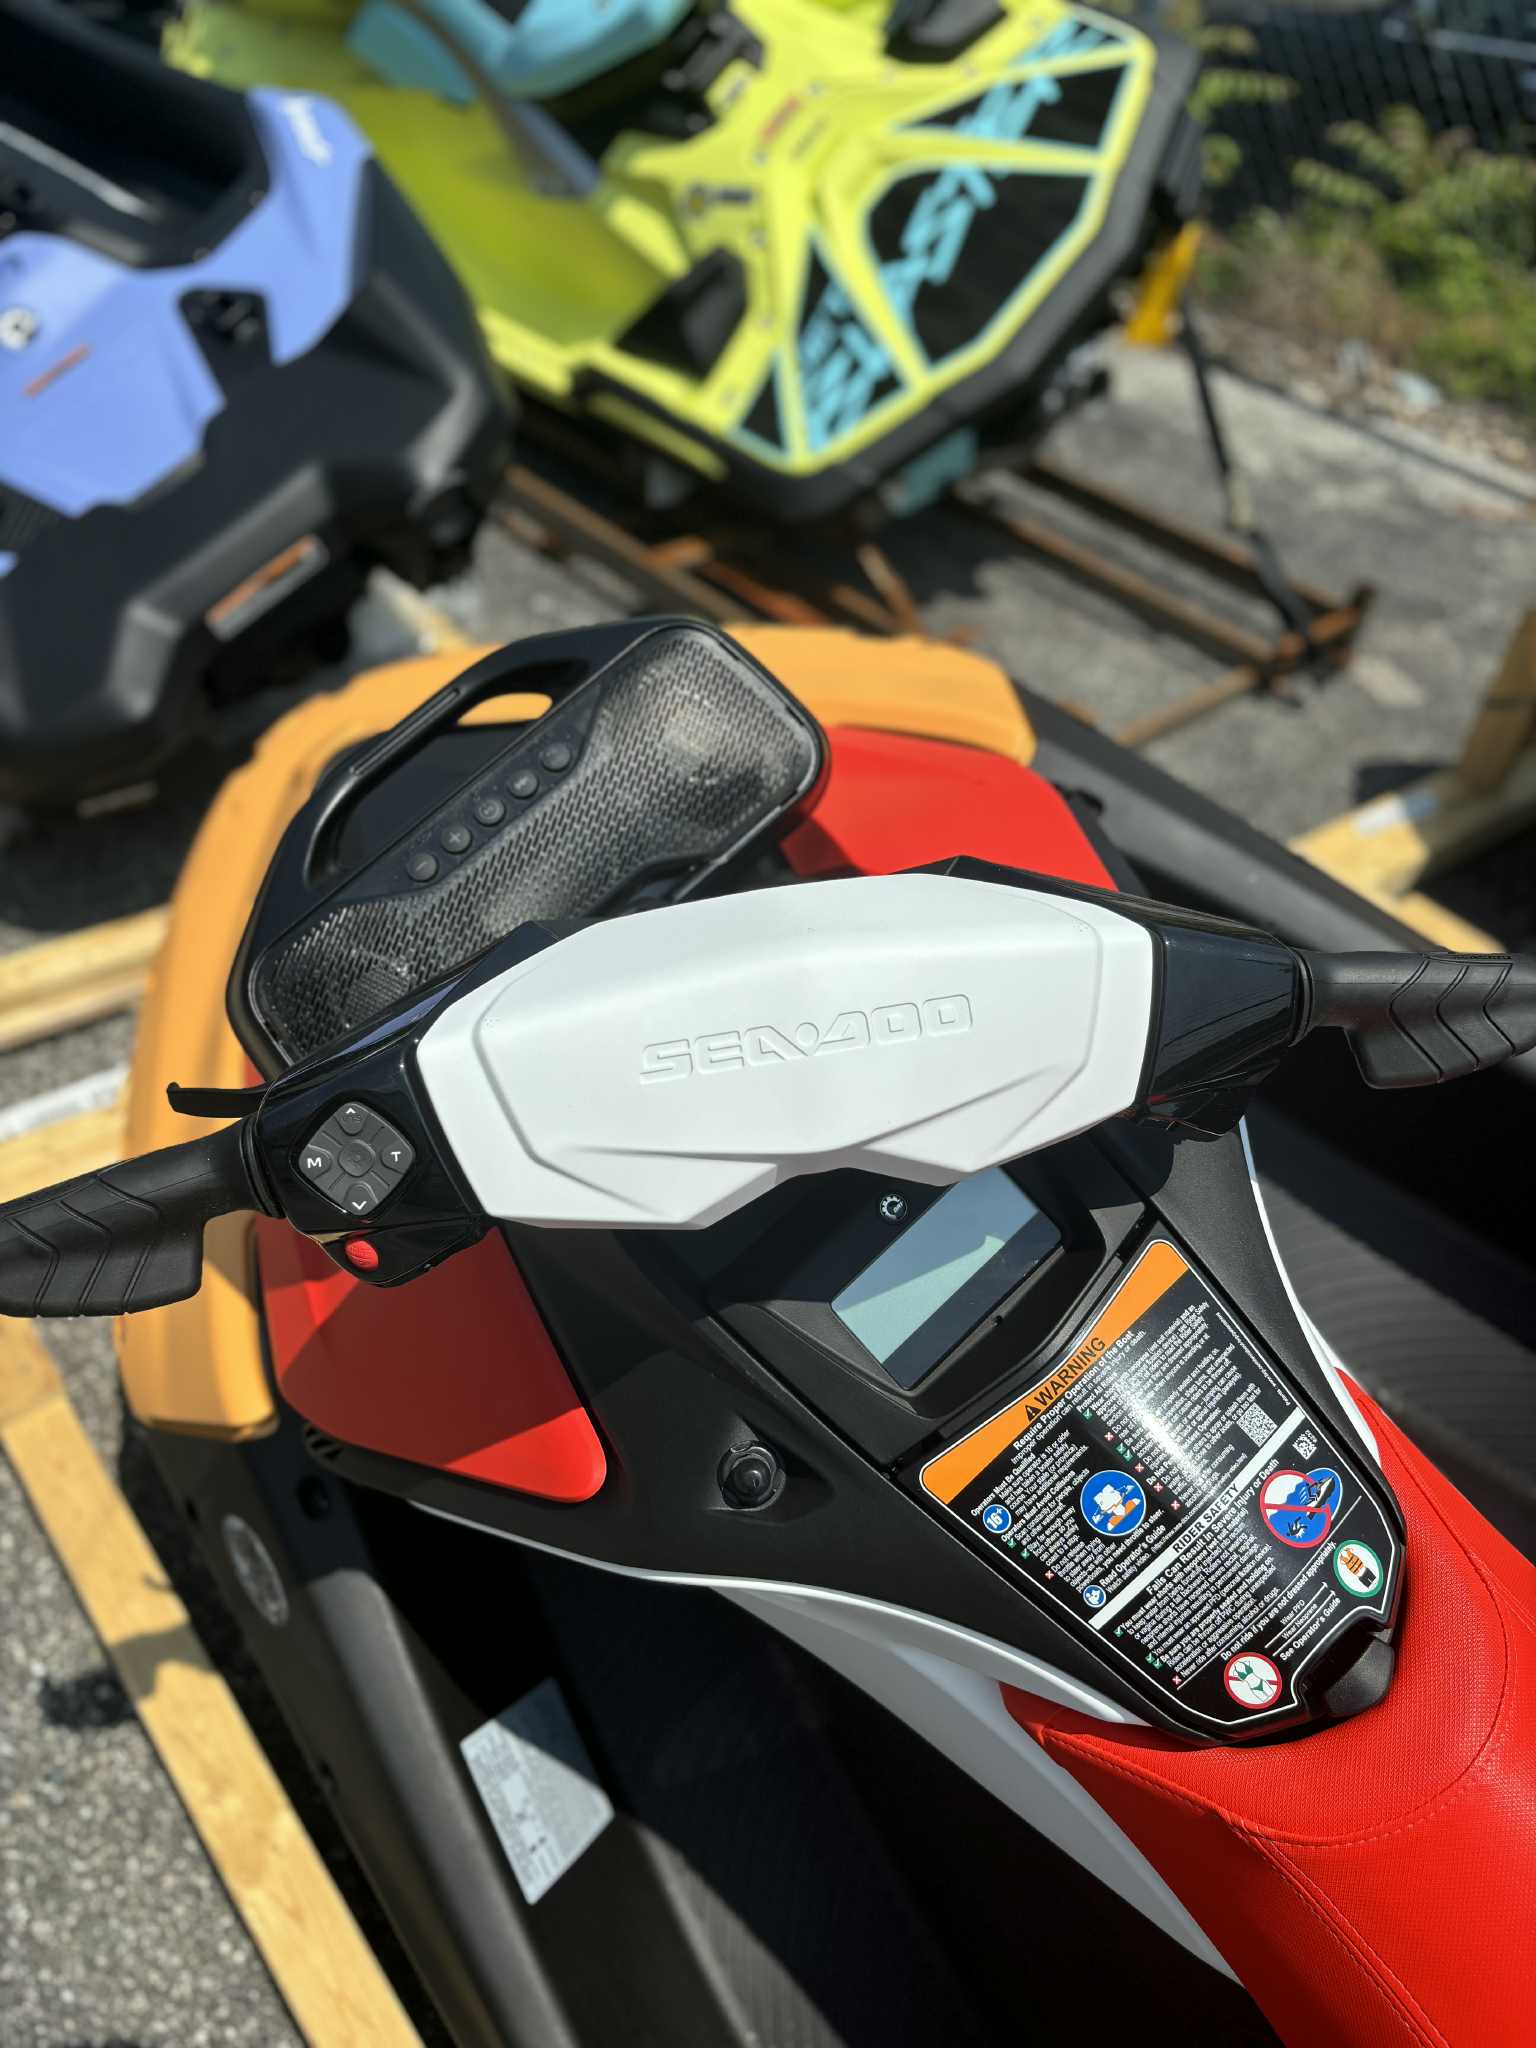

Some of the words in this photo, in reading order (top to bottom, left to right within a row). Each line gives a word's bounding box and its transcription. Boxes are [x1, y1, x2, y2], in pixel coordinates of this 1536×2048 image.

[307, 1157, 322, 1169] M
[390, 1151, 402, 1163] T
[1013, 1421, 1044, 1452] Require
[1040, 1397, 1068, 1425] Proper
[1063, 1363, 1101, 1401] Operation
[1096, 1356, 1107, 1366] of
[1104, 1345, 1118, 1359] the
[1115, 1330, 1133, 1348] Boat
[1034, 1335, 1106, 1407] WARNING
[1011, 1438, 1038, 1465] Improper
[1034, 1413, 1063, 1442] operation
[1060, 1403, 1073, 1416] can
[1070, 1387, 1088, 1405] result
[1085, 1381, 1094, 1390] in
[1108, 1350, 1126, 1367] injury
[970, 1491, 996, 1518] Operators
[993, 1480, 1007, 1494] Must
[1004, 1473, 1014, 1482] Be
[1012, 1452, 1035, 1476] Qualified
[999, 1485, 1014, 1500] Make
[1012, 1476, 1024, 1487] sure
[1021, 1457, 1043, 1478] operator
[1045, 1446, 1053, 1454] 16
[1056, 1429, 1070, 1443] older
[1004, 1494, 1015, 1505] and
[1013, 1485, 1024, 1496] has
[1022, 1473, 1036, 1487] taken
[1038, 1455, 1054, 1472] boater
[1052, 1442, 1069, 1458] safety
[1009, 1492, 1027, 1510] course.
[1024, 1481, 1038, 1494] Your
[1035, 1470, 1049, 1484] state
[1046, 1464, 1057, 1473] (or
[1053, 1443, 1078, 1467] province)
[1000, 1517, 1026, 1543] Operators
[1023, 1506, 1038, 1520] Must
[1035, 1492, 1051, 1508] Avoid
[1049, 1469, 1075, 1494] Collisions
[1014, 1527, 1028, 1540] Scan
[1025, 1505, 1051, 1530] constantly
[1047, 1499, 1057, 1508] for
[1055, 1483, 1074, 1501] people,
[1070, 1467, 1090, 1486] objects
[1020, 1534, 1031, 1545] and
[1029, 1523, 1043, 1536] other
[1040, 1502, 1065, 1525] watercraft.
[1026, 1539, 1041, 1553] Stay
[1036, 1532, 1047, 1542] far
[1043, 1517, 1064, 1537] enough
[1061, 1506, 1077, 1520] away
[1146, 1575, 1166, 1594] Falls
[1164, 1560, 1182, 1578] Can
[1178, 1538, 1205, 1563] Result
[1202, 1530, 1213, 1540] in
[1210, 1505, 1237, 1532] Severe
[1234, 1485, 1257, 1509] Injury
[1253, 1478, 1263, 1489] or
[1259, 1458, 1279, 1480] Death
[1172, 1521, 1204, 1553] RIDER
[1202, 1483, 1240, 1522] SAFETY
[1033, 1544, 1046, 1557] from
[1043, 1531, 1060, 1547] others
[1064, 1517, 1076, 1528] you
[1051, 1563, 1060, 1572] Do
[1058, 1555, 1068, 1565] not
[1065, 1540, 1085, 1558] release
[1057, 1560, 1075, 1577] throttle
[1072, 1548, 1087, 1562] when
[1085, 1536, 1101, 1552] trying
[1076, 1565, 1105, 1594] powerboats,
[1103, 1556, 1115, 1568] you
[1112, 1543, 1126, 1558] need
[1124, 1526, 1144, 1546] throttle
[1147, 1507, 1163, 1523] steer.
[1099, 1569, 1118, 1587] Read
[1114, 1540, 1149, 1573] Operator's
[1144, 1523, 1166, 1543] Guide
[1106, 1577, 1123, 1593] Watch
[1120, 1564, 1138, 1580] safety
[1134, 1551, 1151, 1566] video.
[1120, 1618, 1133, 1630] You
[1130, 1606, 1145, 1621] must
[1143, 1596, 1158, 1609] wear
[1154, 1580, 1173, 1598] shorts
[1170, 1570, 1184, 1583] with
[1183, 1549, 1209, 1573] neoprene
[1216, 1527, 1229, 1540] suit
[1220, 1650, 1232, 1660] Do
[1229, 1640, 1242, 1652] not
[1239, 1630, 1253, 1643] ride
[1250, 1625, 1259, 1633] if
[1256, 1616, 1270, 1630] you
[1267, 1607, 1278, 1618] are
[1275, 1596, 1289, 1609] not
[1285, 1574, 1308, 1599] dressed
[1304, 1540, 1338, 1578] appropriately.
[1160, 1653, 1170, 1662] Be
[1169, 1644, 1182, 1655] sure
[1180, 1635, 1192, 1646] you
[1190, 1627, 1200, 1636] are
[1198, 1607, 1221, 1630] properly
[1218, 1591, 1237, 1609] seated
[1235, 1582, 1247, 1593] and
[1245, 1563, 1266, 1584] holding
[1264, 1556, 1273, 1565] on.
[1180, 1662, 1196, 1677] Never
[1194, 1653, 1206, 1664] ride
[1203, 1644, 1217, 1656] after
[1215, 1620, 1243, 1647] consuming
[1239, 1604, 1259, 1623] alcohol
[1257, 1600, 1265, 1608] or
[1262, 1585, 1281, 1603] drugs.
[1279, 1646, 1294, 1660] See
[1292, 1614, 1326, 1650] Operator's
[1322, 1596, 1341, 1617] Guide
[1280, 1610, 1294, 1625] Wear
[1292, 1599, 1305, 1612] PFD
[1281, 1624, 1296, 1640] Wear
[1294, 1602, 1319, 1627] Neoprene
